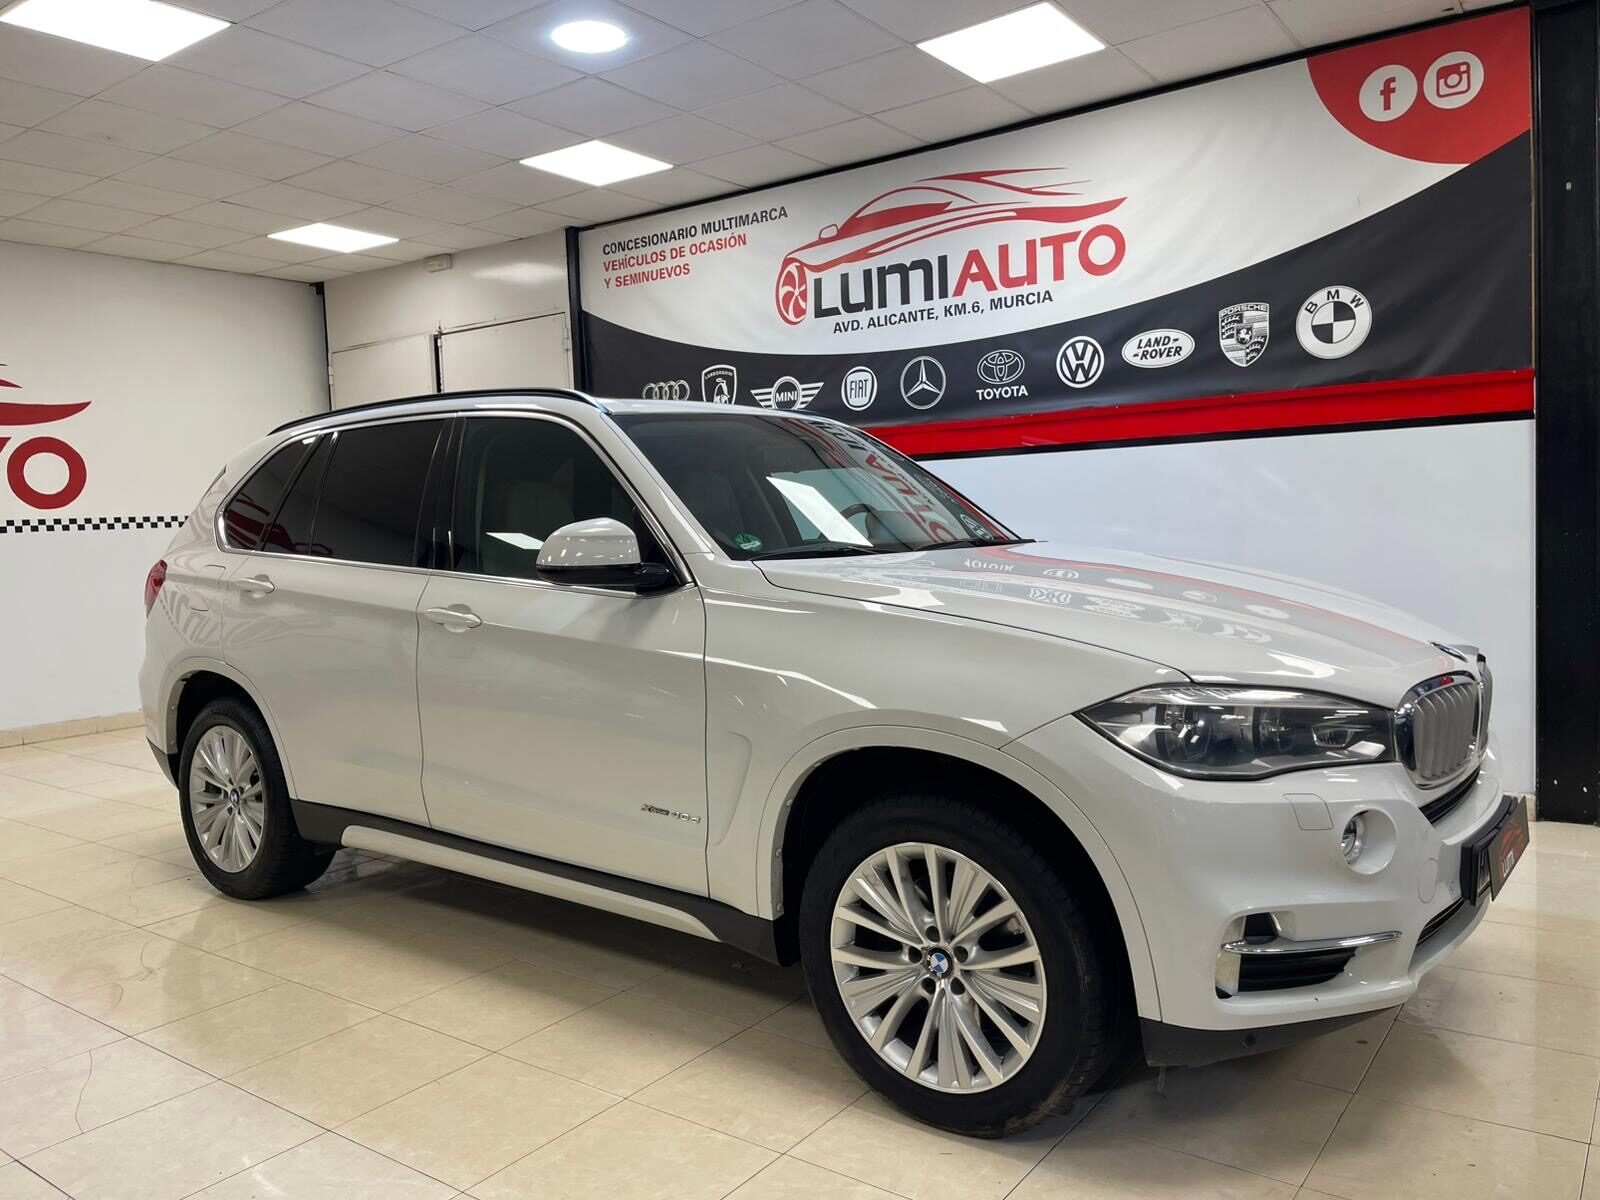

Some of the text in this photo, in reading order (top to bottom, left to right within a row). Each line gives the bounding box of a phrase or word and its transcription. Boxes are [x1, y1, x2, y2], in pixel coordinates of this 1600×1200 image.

[602, 206, 788, 256] CONCESIONARIO MULTIMARCA
[603, 233, 747, 272] VEHÍCULOS DE OCASIÓN
[604, 263, 691, 289] Y SEMINUEVOS
[833, 290, 1054, 335] AVD. ALICANTE, KM.6, MURCIA
[1305, 288, 1364, 315] BMW
[775, 390, 798, 403] MINI
[850, 378, 869, 400] FIAT
[976, 385, 1029, 401] TOYOTA
